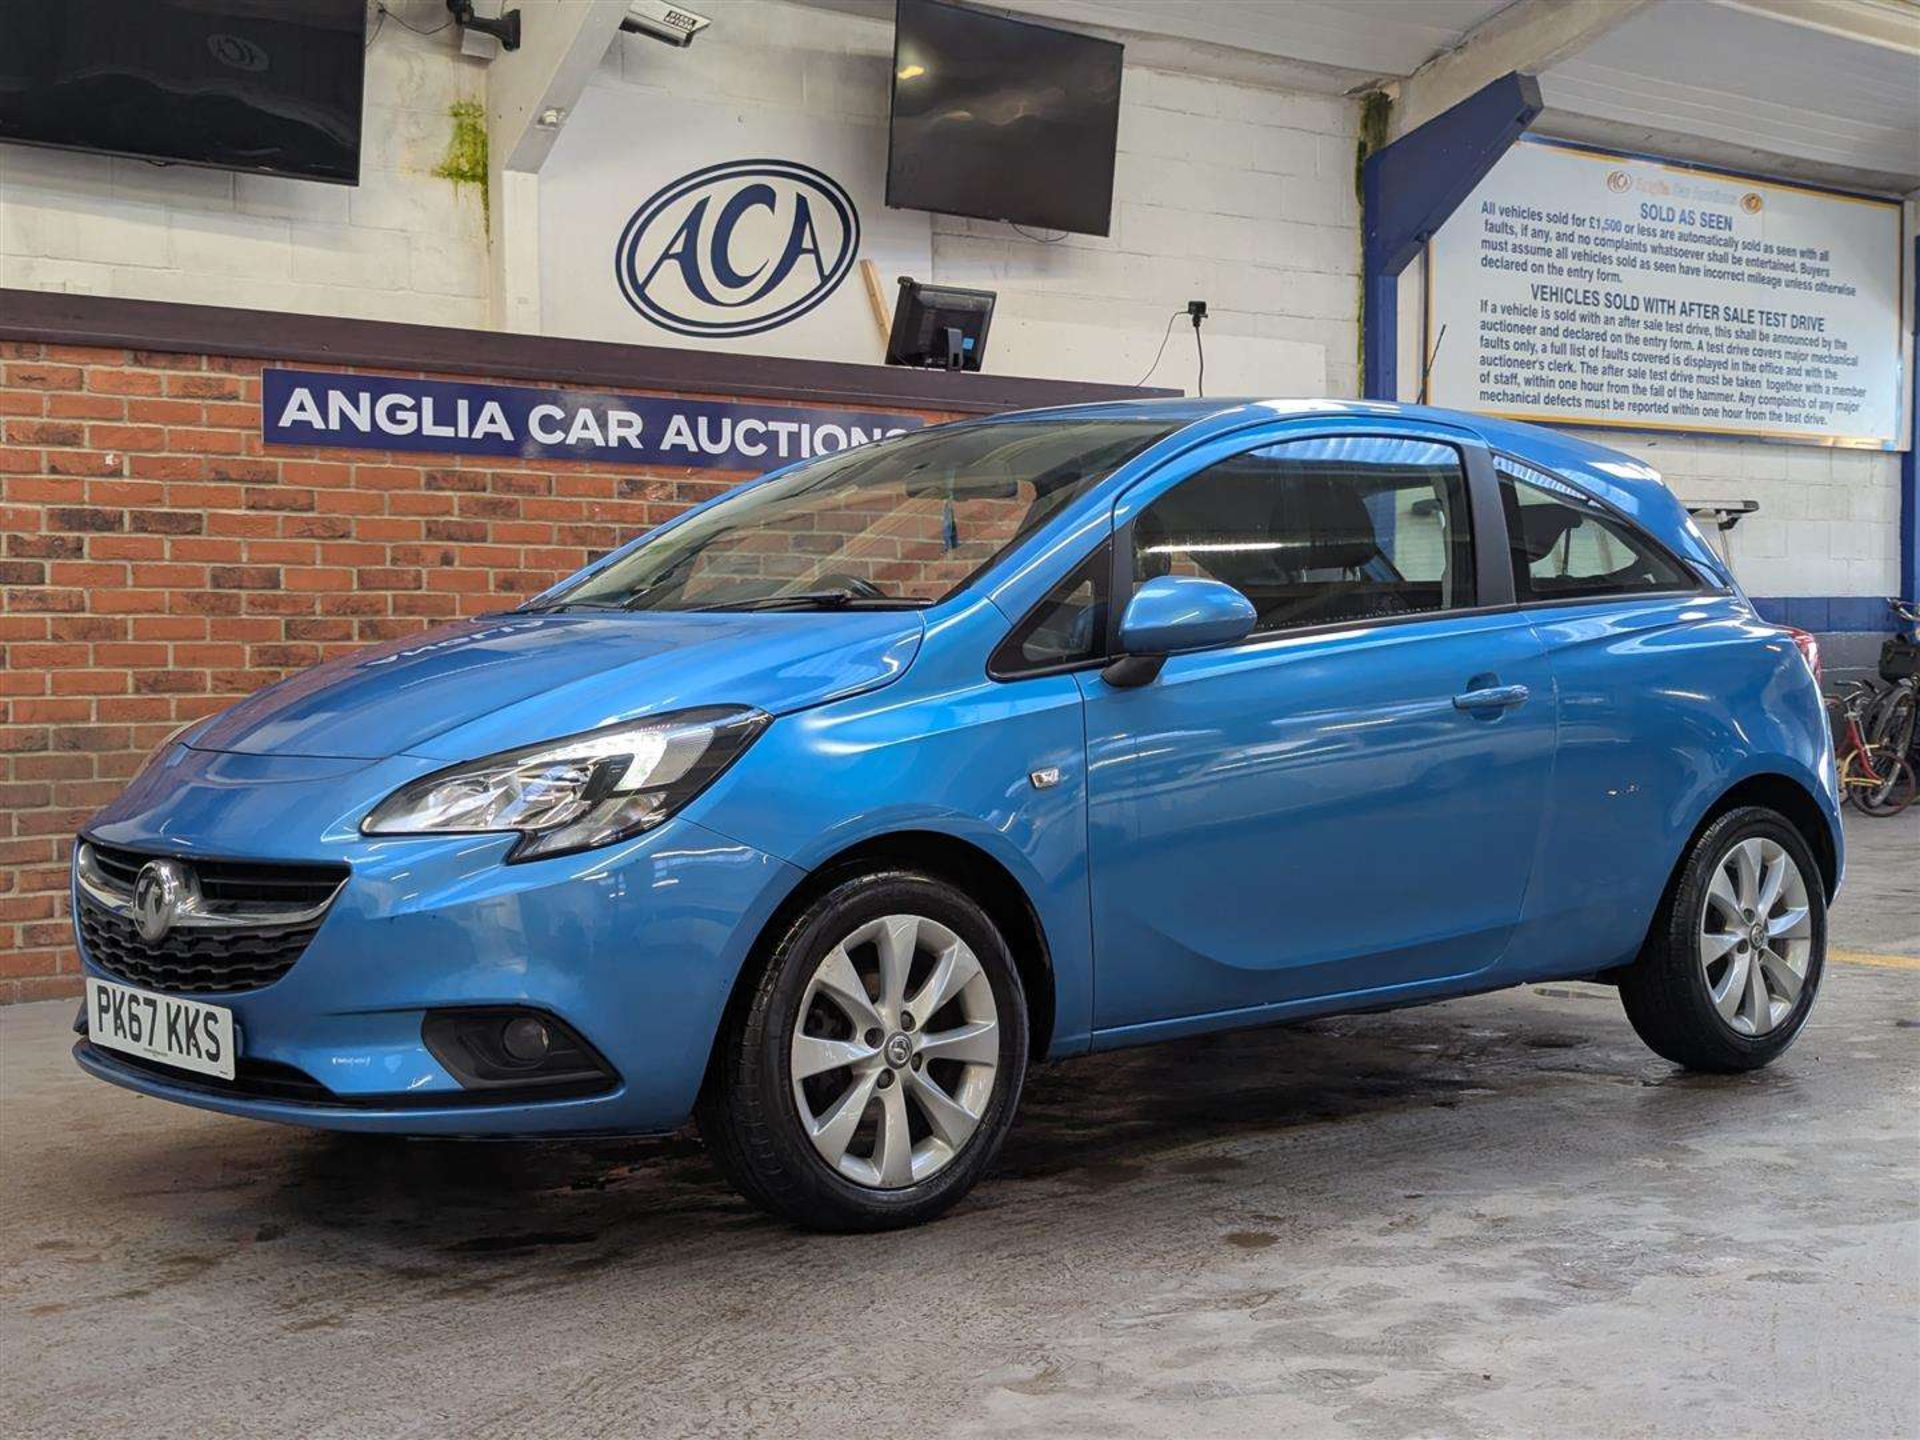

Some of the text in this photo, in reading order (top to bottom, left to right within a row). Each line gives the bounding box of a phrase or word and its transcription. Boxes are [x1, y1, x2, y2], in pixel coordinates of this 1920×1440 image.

[1481, 201, 1830, 262] All vehicles sold for £1,500 or less are automatically sold as seen with all
[1640, 203, 1733, 232] SOLD AS SEEN
[641, 184, 826, 307] ACA
[1481, 239, 1856, 296] must assume all vehicles sold as seen have incorrect mileage unless otherwise
[1481, 254, 1622, 283] declared on the entry form.
[1484, 219, 1830, 278] faults, if any, and no complaints whatsoever shall be entertained. Buyers
[1480, 300, 1847, 351] If a vehicle is sold with an after sale test drive, this shall be announced by the
[1531, 284, 1825, 332] VEHICLES SOLD WITH AFTER SALE TEST DRIVE
[1480, 321, 1858, 366] auctioneer and declared on the entry form. A test drive covers major mechanical
[1480, 336, 1838, 380] faults only, a full list of faults covered is displayed in the office and with the
[1480, 356, 1545, 370] auctioneer's
[1548, 360, 1577, 373] clerk.
[1580, 362, 1599, 375] The
[1602, 365, 1624, 377] after
[1627, 367, 1646, 379] sale
[1649, 369, 1668, 381] test
[1670, 370, 1694, 383] drive
[1696, 375, 1720, 385] must
[1722, 375, 1734, 386] be
[1736, 377, 1762, 388] taken
[1766, 380, 1803, 393] together
[1806, 383, 1823, 394] with
[1480, 371, 1860, 414] of staff, within one hour from the fall of the hammer. Any complaints of any major
[278, 388, 908, 459] ANGLIA CAR AUCTION
[1480, 390, 1828, 424] mechanical defects must be reported within one hour from the test drive.
[97, 985, 221, 1062] PK67 KKS
